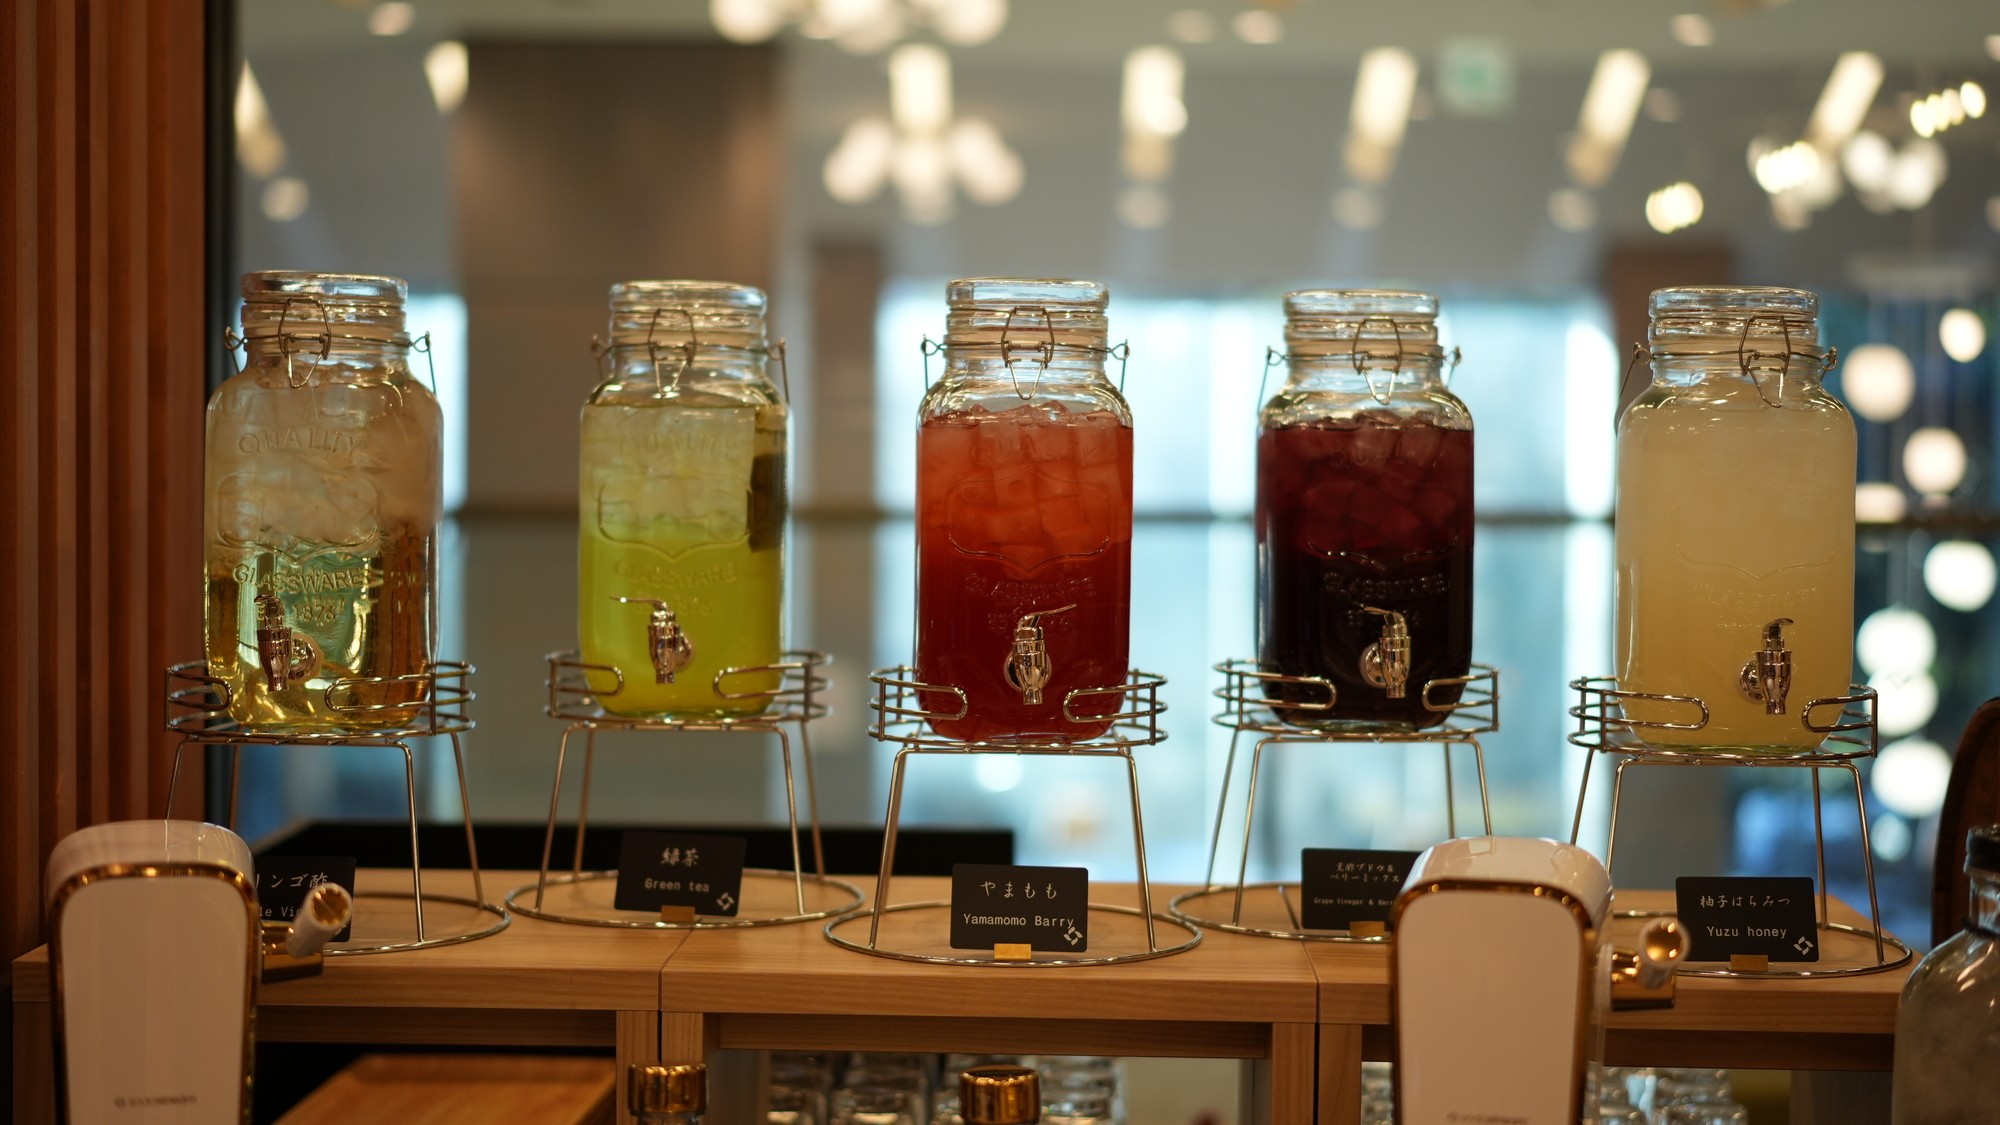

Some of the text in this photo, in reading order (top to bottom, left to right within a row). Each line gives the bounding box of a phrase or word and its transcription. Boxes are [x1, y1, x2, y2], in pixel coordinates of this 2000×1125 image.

[238, 427, 362, 457] QUALITY
[232, 563, 363, 594] GLASSWARE
[660, 847, 699, 867] 緑茶
[644, 878, 710, 892] Green tea
[980, 881, 1057, 899] やまもも
[1699, 895, 1790, 908] 柚子はちみつ
[963, 913, 1074, 929] Yamamomo Barry
[1707, 926, 1787, 939] Yuzu honey
